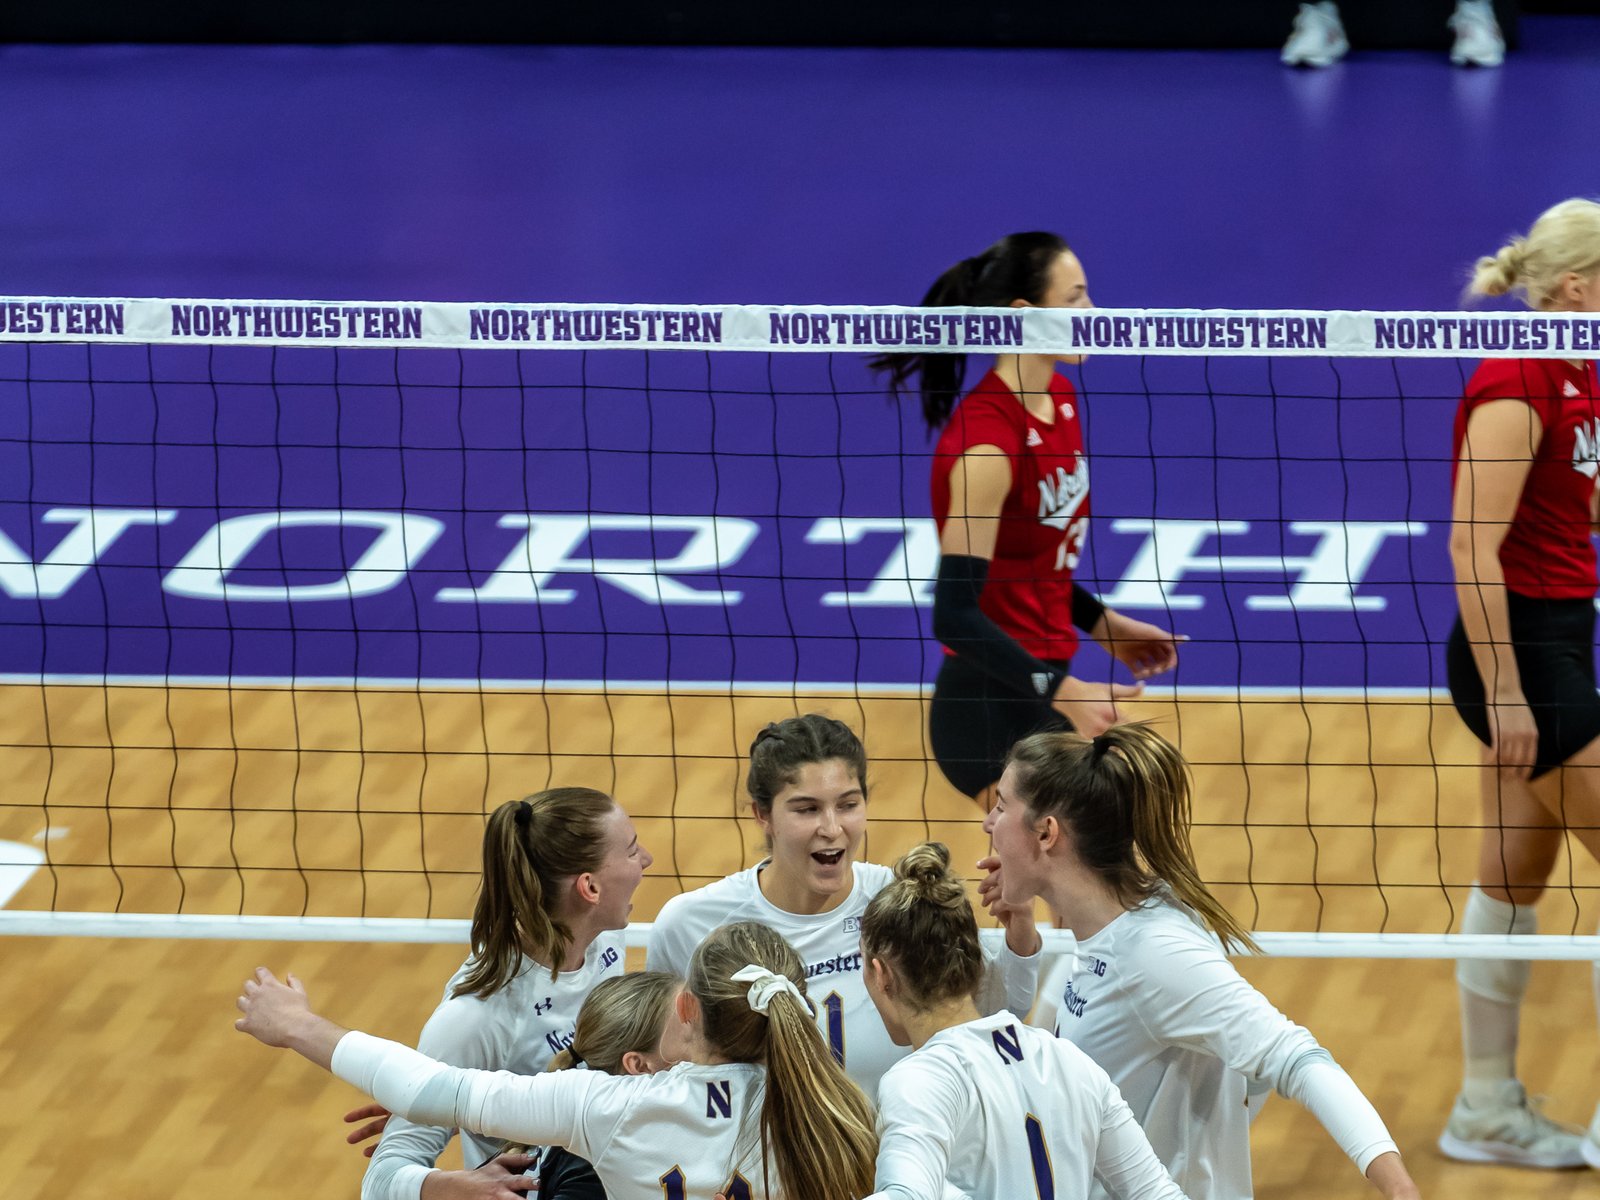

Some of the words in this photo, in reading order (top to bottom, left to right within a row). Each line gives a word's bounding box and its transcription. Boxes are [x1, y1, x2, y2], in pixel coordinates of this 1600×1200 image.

[0, 302, 124, 335] ESTERN
[171, 304, 423, 339] NORTHWESTERN
[469, 309, 723, 343] NORTHWESTERN
[769, 312, 1024, 347] NORTHWESTERN
[1071, 315, 1328, 349] NORTHWESTERN
[991, 1023, 1025, 1066] N
[706, 1079, 732, 1120] N
